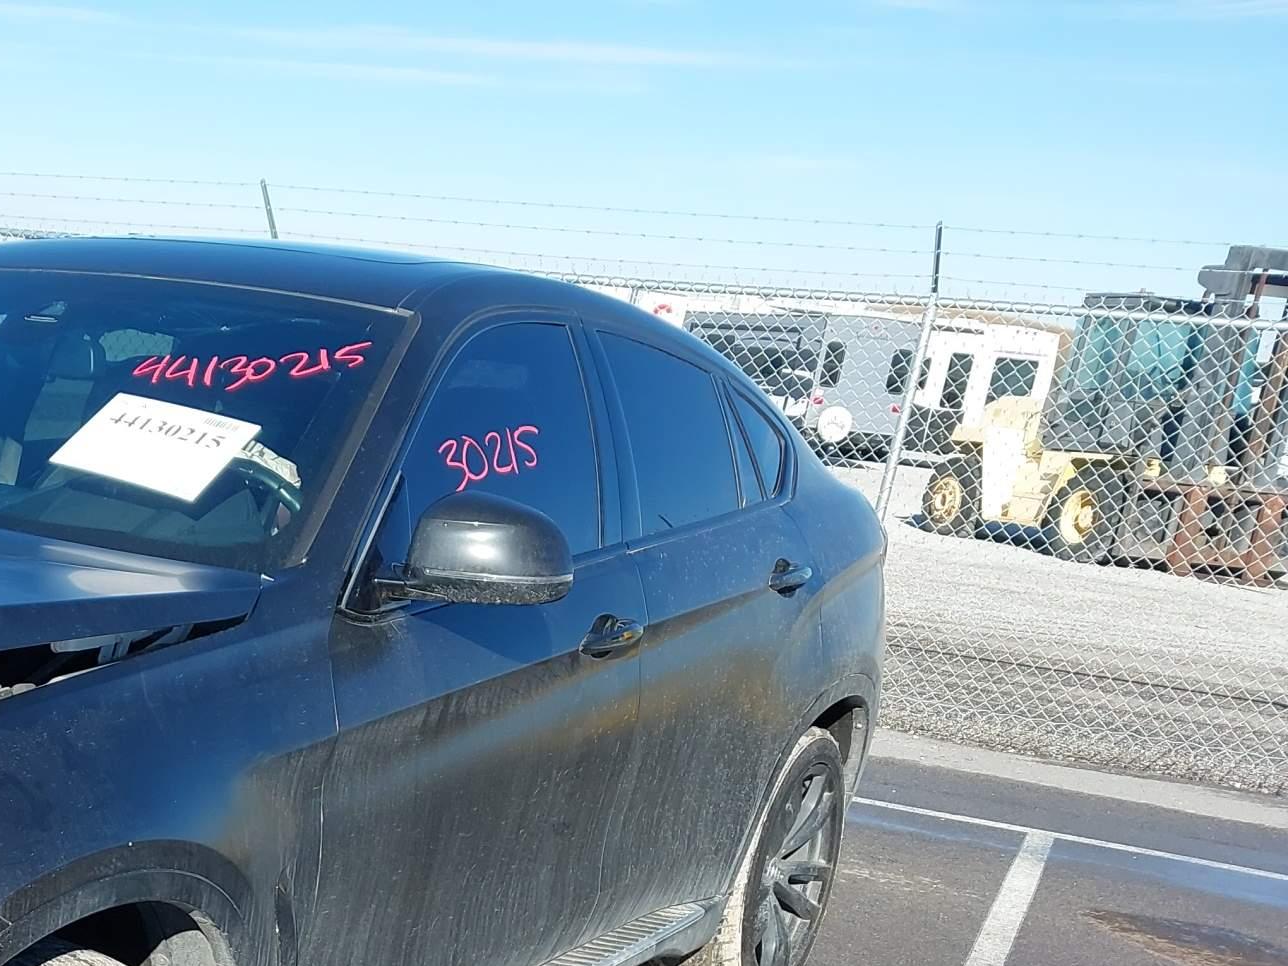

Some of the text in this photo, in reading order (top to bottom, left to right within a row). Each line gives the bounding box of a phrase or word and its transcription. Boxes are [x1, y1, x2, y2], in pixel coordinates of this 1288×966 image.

[132, 341, 372, 392] 44130215
[109, 412, 227, 449] 44130215
[438, 425, 540, 492] 30215
